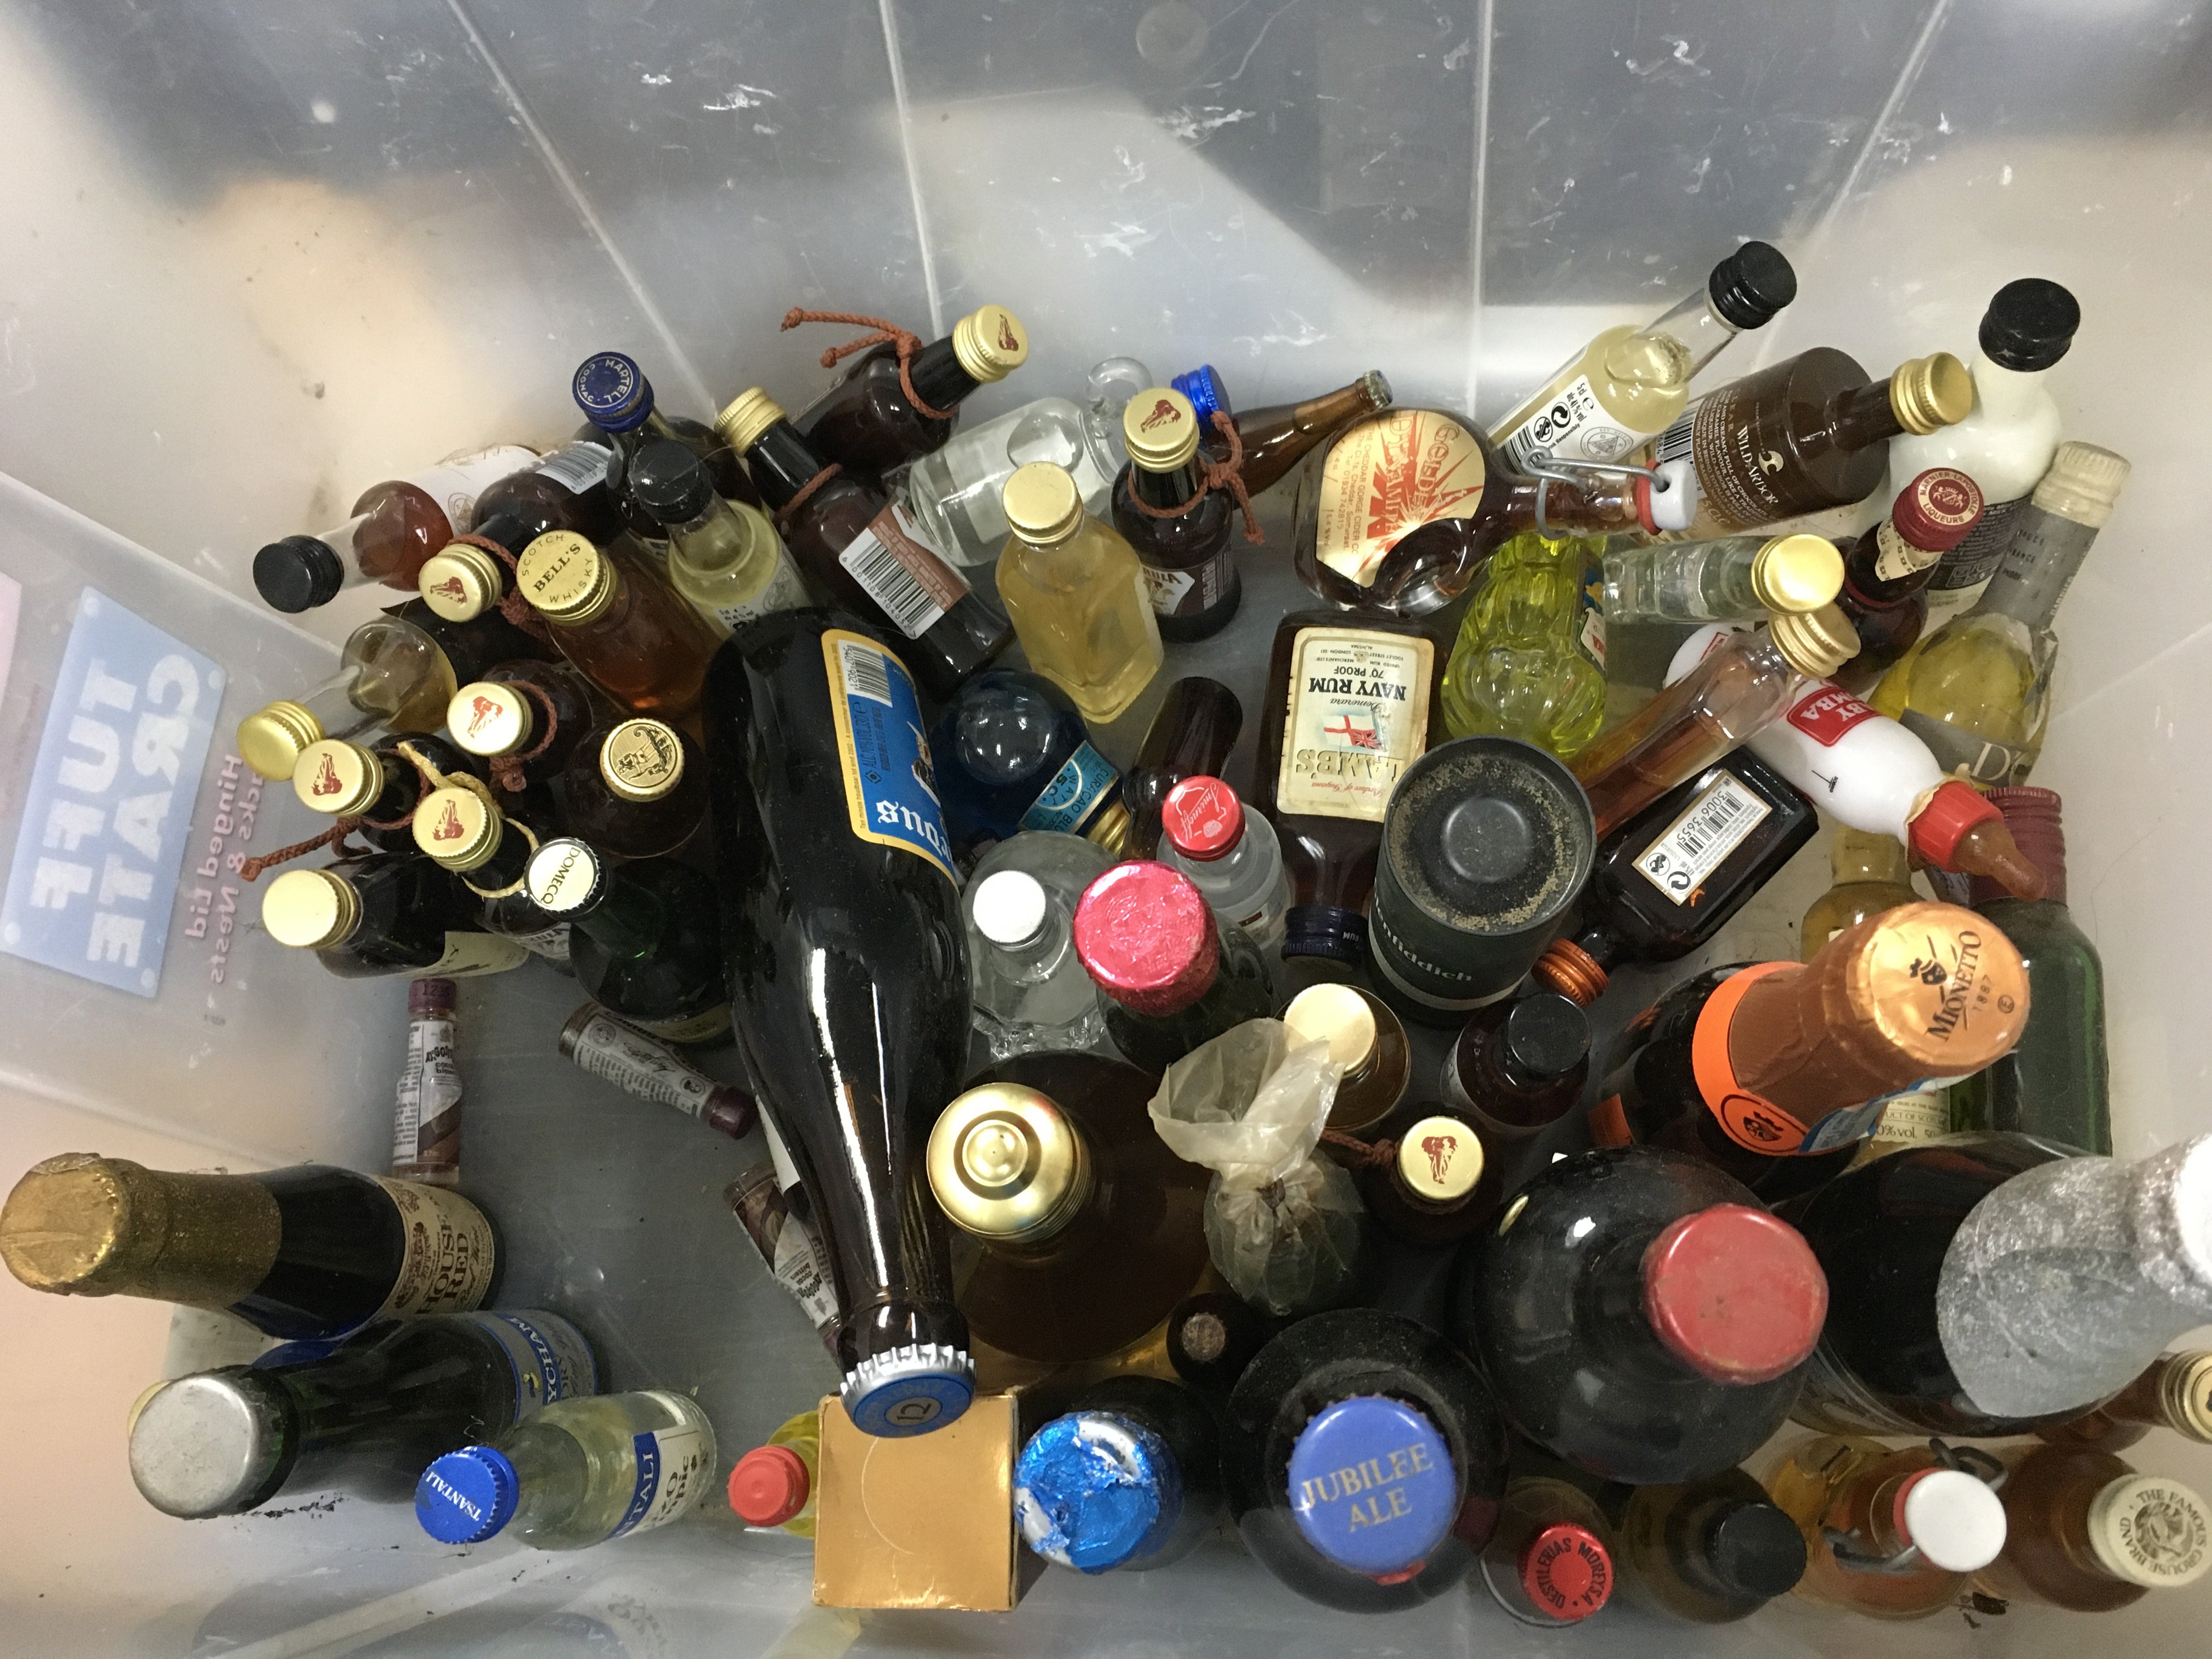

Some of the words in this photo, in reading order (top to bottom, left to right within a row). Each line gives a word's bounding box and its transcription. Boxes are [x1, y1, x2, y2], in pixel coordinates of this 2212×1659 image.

[580, 364, 595, 402] COGNAC
[604, 359, 630, 403] MARTELL
[1576, 382, 1586, 391] 5
[1575, 410, 1588, 422] vol
[1359, 444, 1371, 482] CHEDDAR
[1724, 455, 1734, 475] FULL
[1731, 475, 1740, 486] OF
[1355, 484, 1365, 514] GORGE
[1725, 477, 1737, 493] LIKE
[1923, 503, 1964, 523] LIQUEURS
[1352, 515, 1361, 541] CIDER
[522, 534, 564, 576] SCOTCH
[533, 543, 581, 592] BELL'S
[550, 557, 594, 603] WHISKY
[843, 647, 855, 665] 5407
[1333, 665, 1366, 676] PROOF
[847, 670, 859, 686] 9021
[1308, 678, 1353, 694] RUM
[1355, 680, 1407, 701] NAVY
[1330, 698, 1383, 712] Demerara
[1296, 749, 1404, 782] LAMB'S
[852, 776, 862, 800] houdbaar
[1046, 772, 1068, 798] 50
[1052, 774, 1079, 804] WATT
[1070, 769, 1108, 814] CURAÇAO
[1311, 781, 1344, 794] Guyana
[1180, 783, 1220, 843] Smirnoff
[1701, 790, 1728, 818] 3006
[1054, 814, 1073, 832] BLU
[1675, 816, 1702, 843] 3655
[1660, 842, 1681, 861] LIQUEUR
[540, 847, 581, 906] DOMECQ
[1343, 932, 1359, 941] RUM
[1374, 877, 1473, 982] lenfiddich
[1925, 931, 1982, 1042] MIONETTO
[1972, 974, 1992, 1012] 1887
[1898, 1126, 1917, 1138] vol.
[443, 1233, 469, 1298] RED
[896, 1403, 932, 1421] 12
[1300, 1442, 1434, 1510] JUBILEE
[425, 1470, 483, 1522] TSANTALI
[1347, 1487, 1413, 1533] ALE
[2136, 1488, 2165, 1503] THE
[2170, 1492, 2207, 1547] FAMOUS
[2119, 1516, 2147, 1566] BRAND
[1537, 1537, 1571, 1609] DESTILERIAS
[2149, 1549, 2203, 1576] GROUSE
